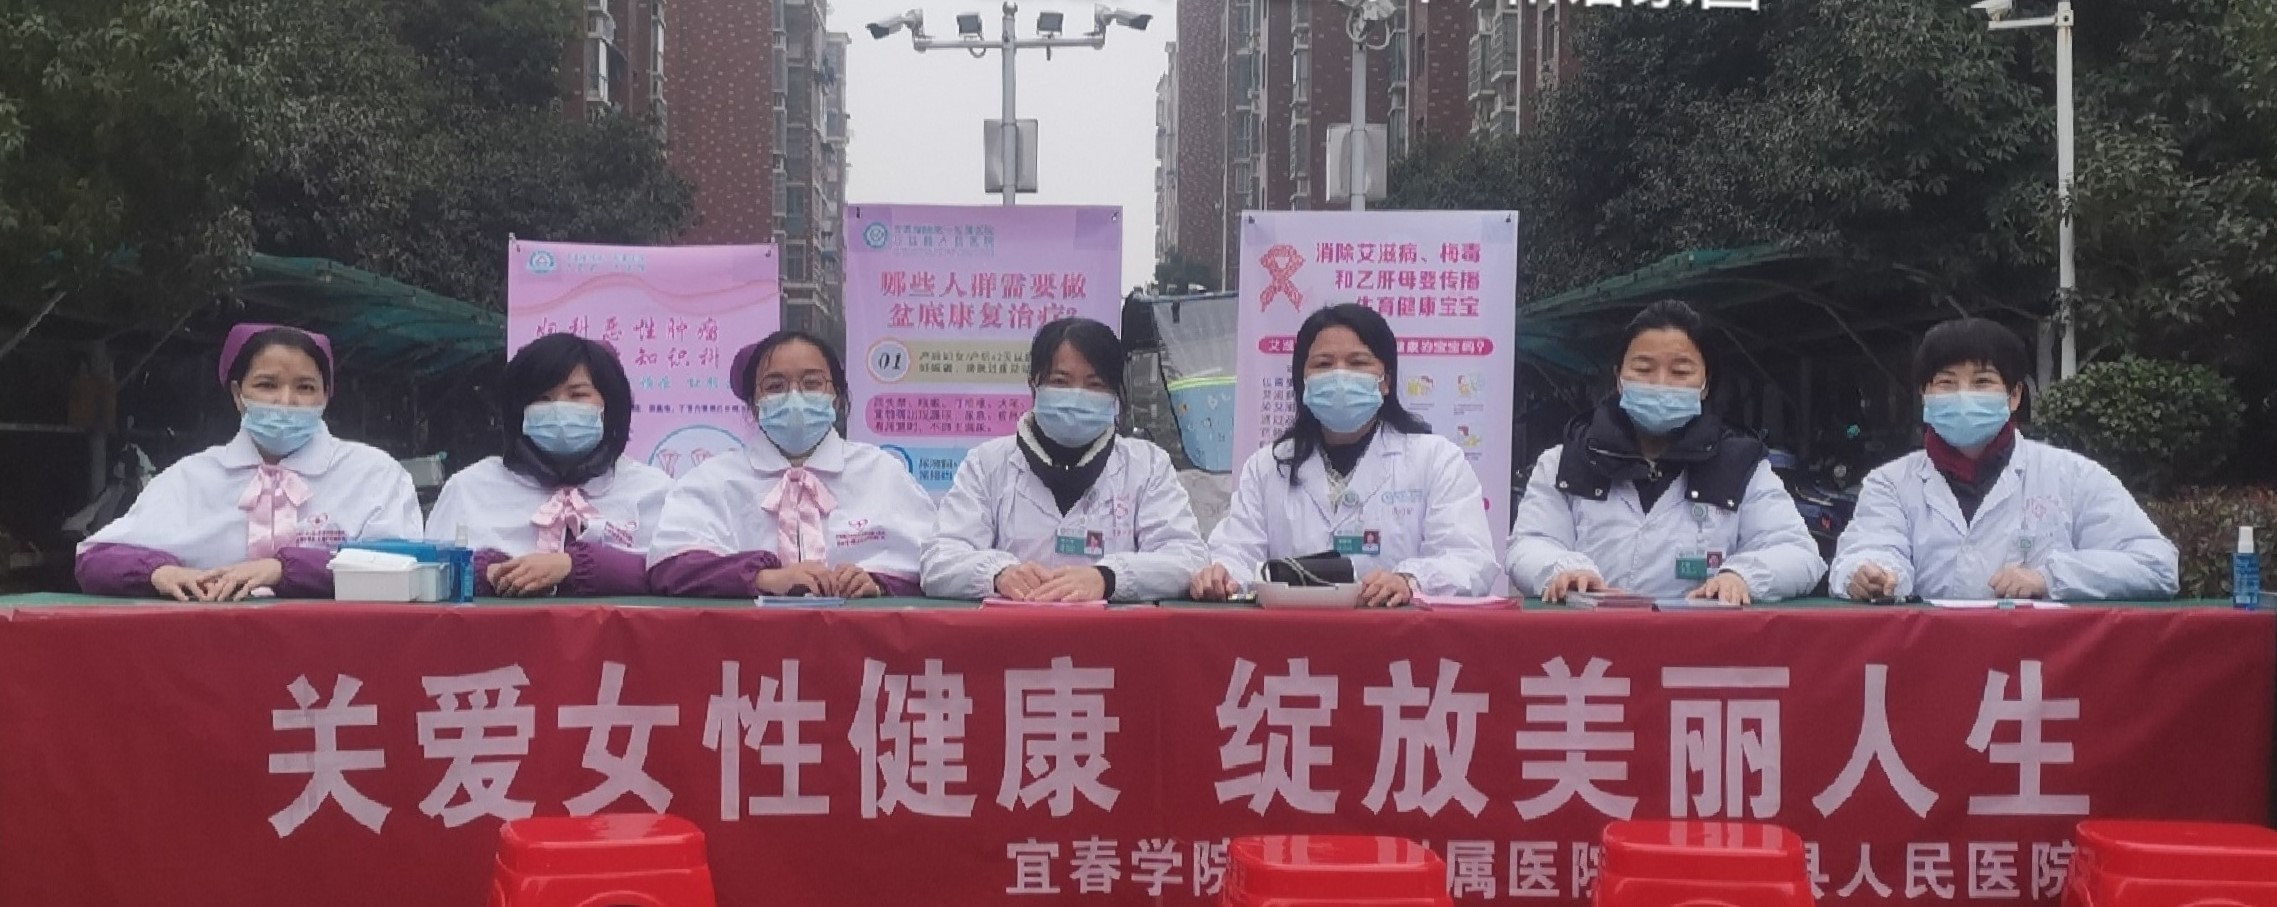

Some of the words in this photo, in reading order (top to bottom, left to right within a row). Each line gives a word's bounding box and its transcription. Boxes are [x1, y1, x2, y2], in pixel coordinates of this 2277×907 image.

[1316, 242, 1481, 264] 消除艾滋病、梅毒
[880, 271, 1087, 299] 哪些人群需要做
[1335, 270, 1480, 290] 和乙肝母婴传播
[1356, 296, 1479, 317] 生育健康宝宝
[878, 352, 901, 371] 01
[267, 656, 1121, 838] 关爱女性健康
[1214, 656, 2089, 821] 绽放美丽人生
[1005, 836, 1230, 898] 宜春学院
[1421, 838, 1600, 898] 属医院
